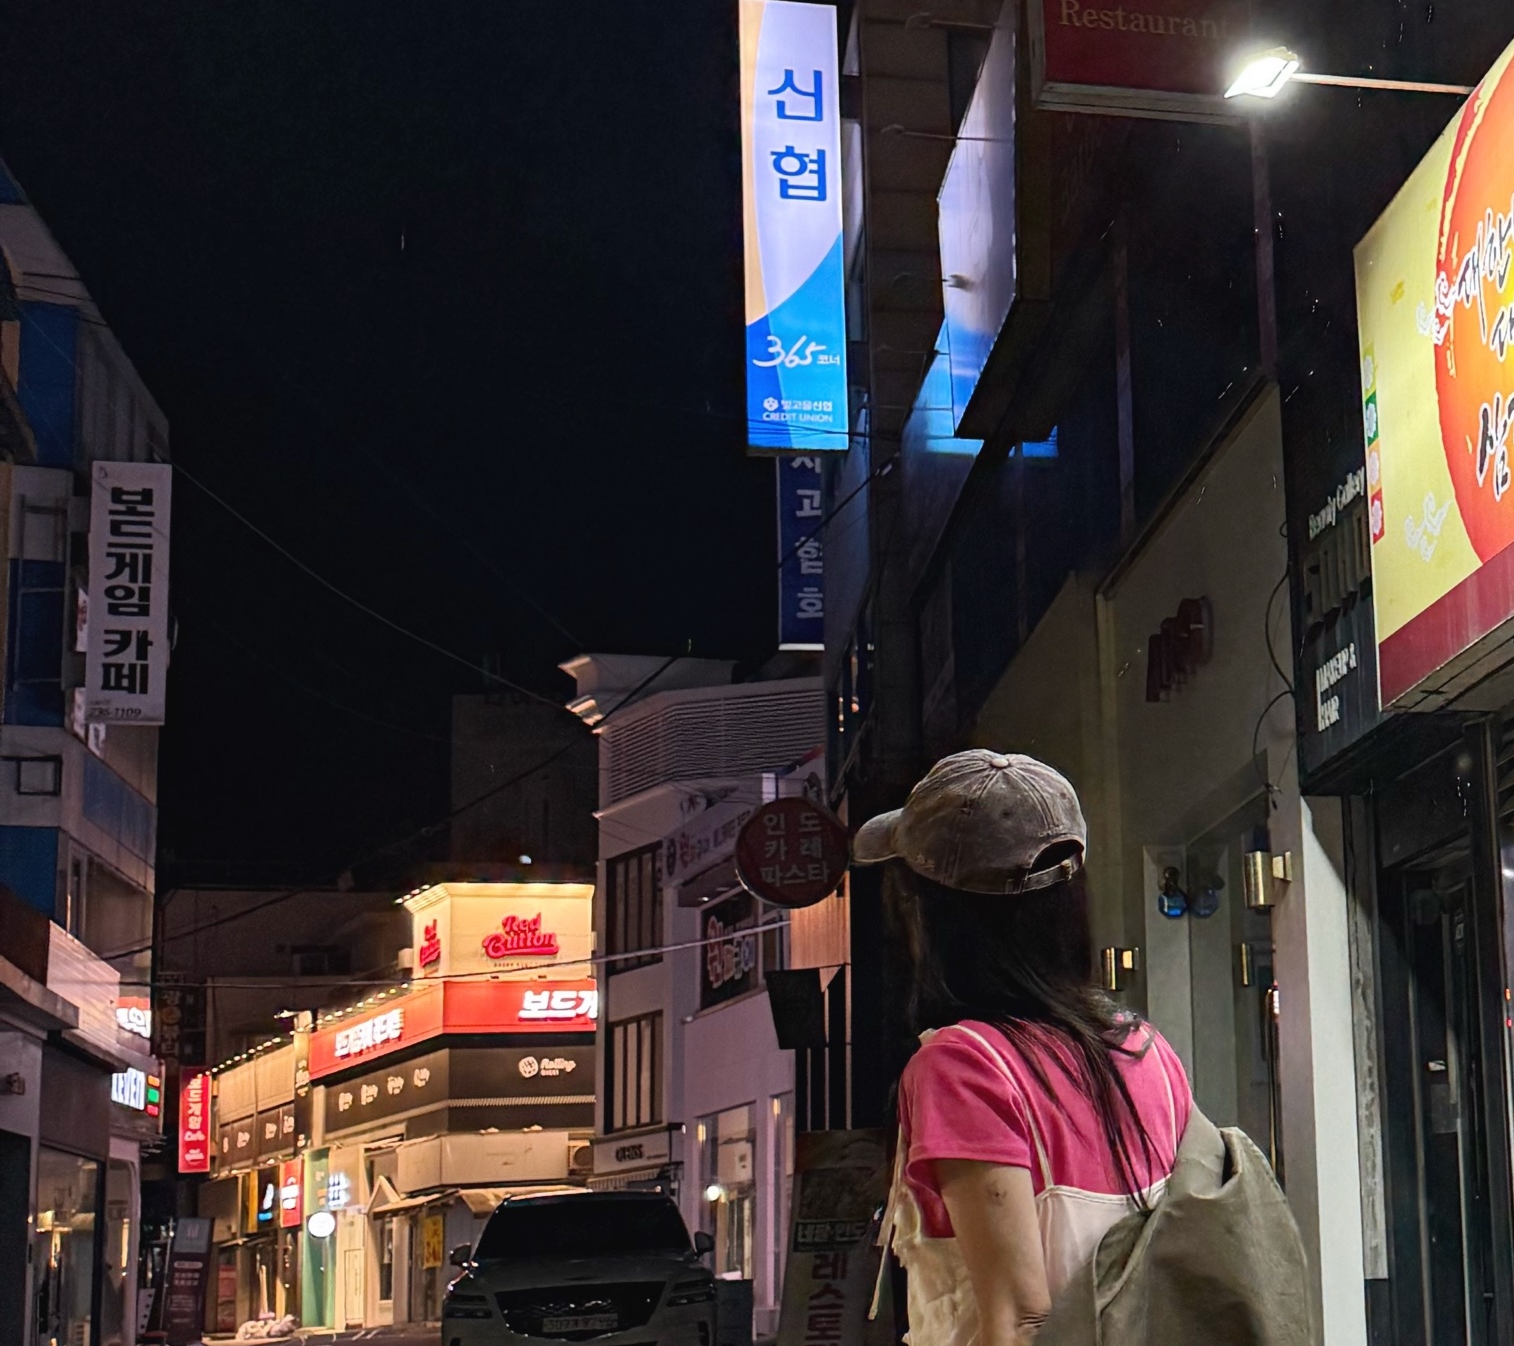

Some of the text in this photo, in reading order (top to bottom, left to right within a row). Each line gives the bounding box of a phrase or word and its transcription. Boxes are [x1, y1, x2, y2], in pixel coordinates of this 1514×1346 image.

[766, 66, 828, 202] 신협
[752, 335, 827, 368] 365
[799, 413, 833, 423] UNION
[101, 486, 156, 695] 보드게임 카페
[501, 912, 542, 936] Red
